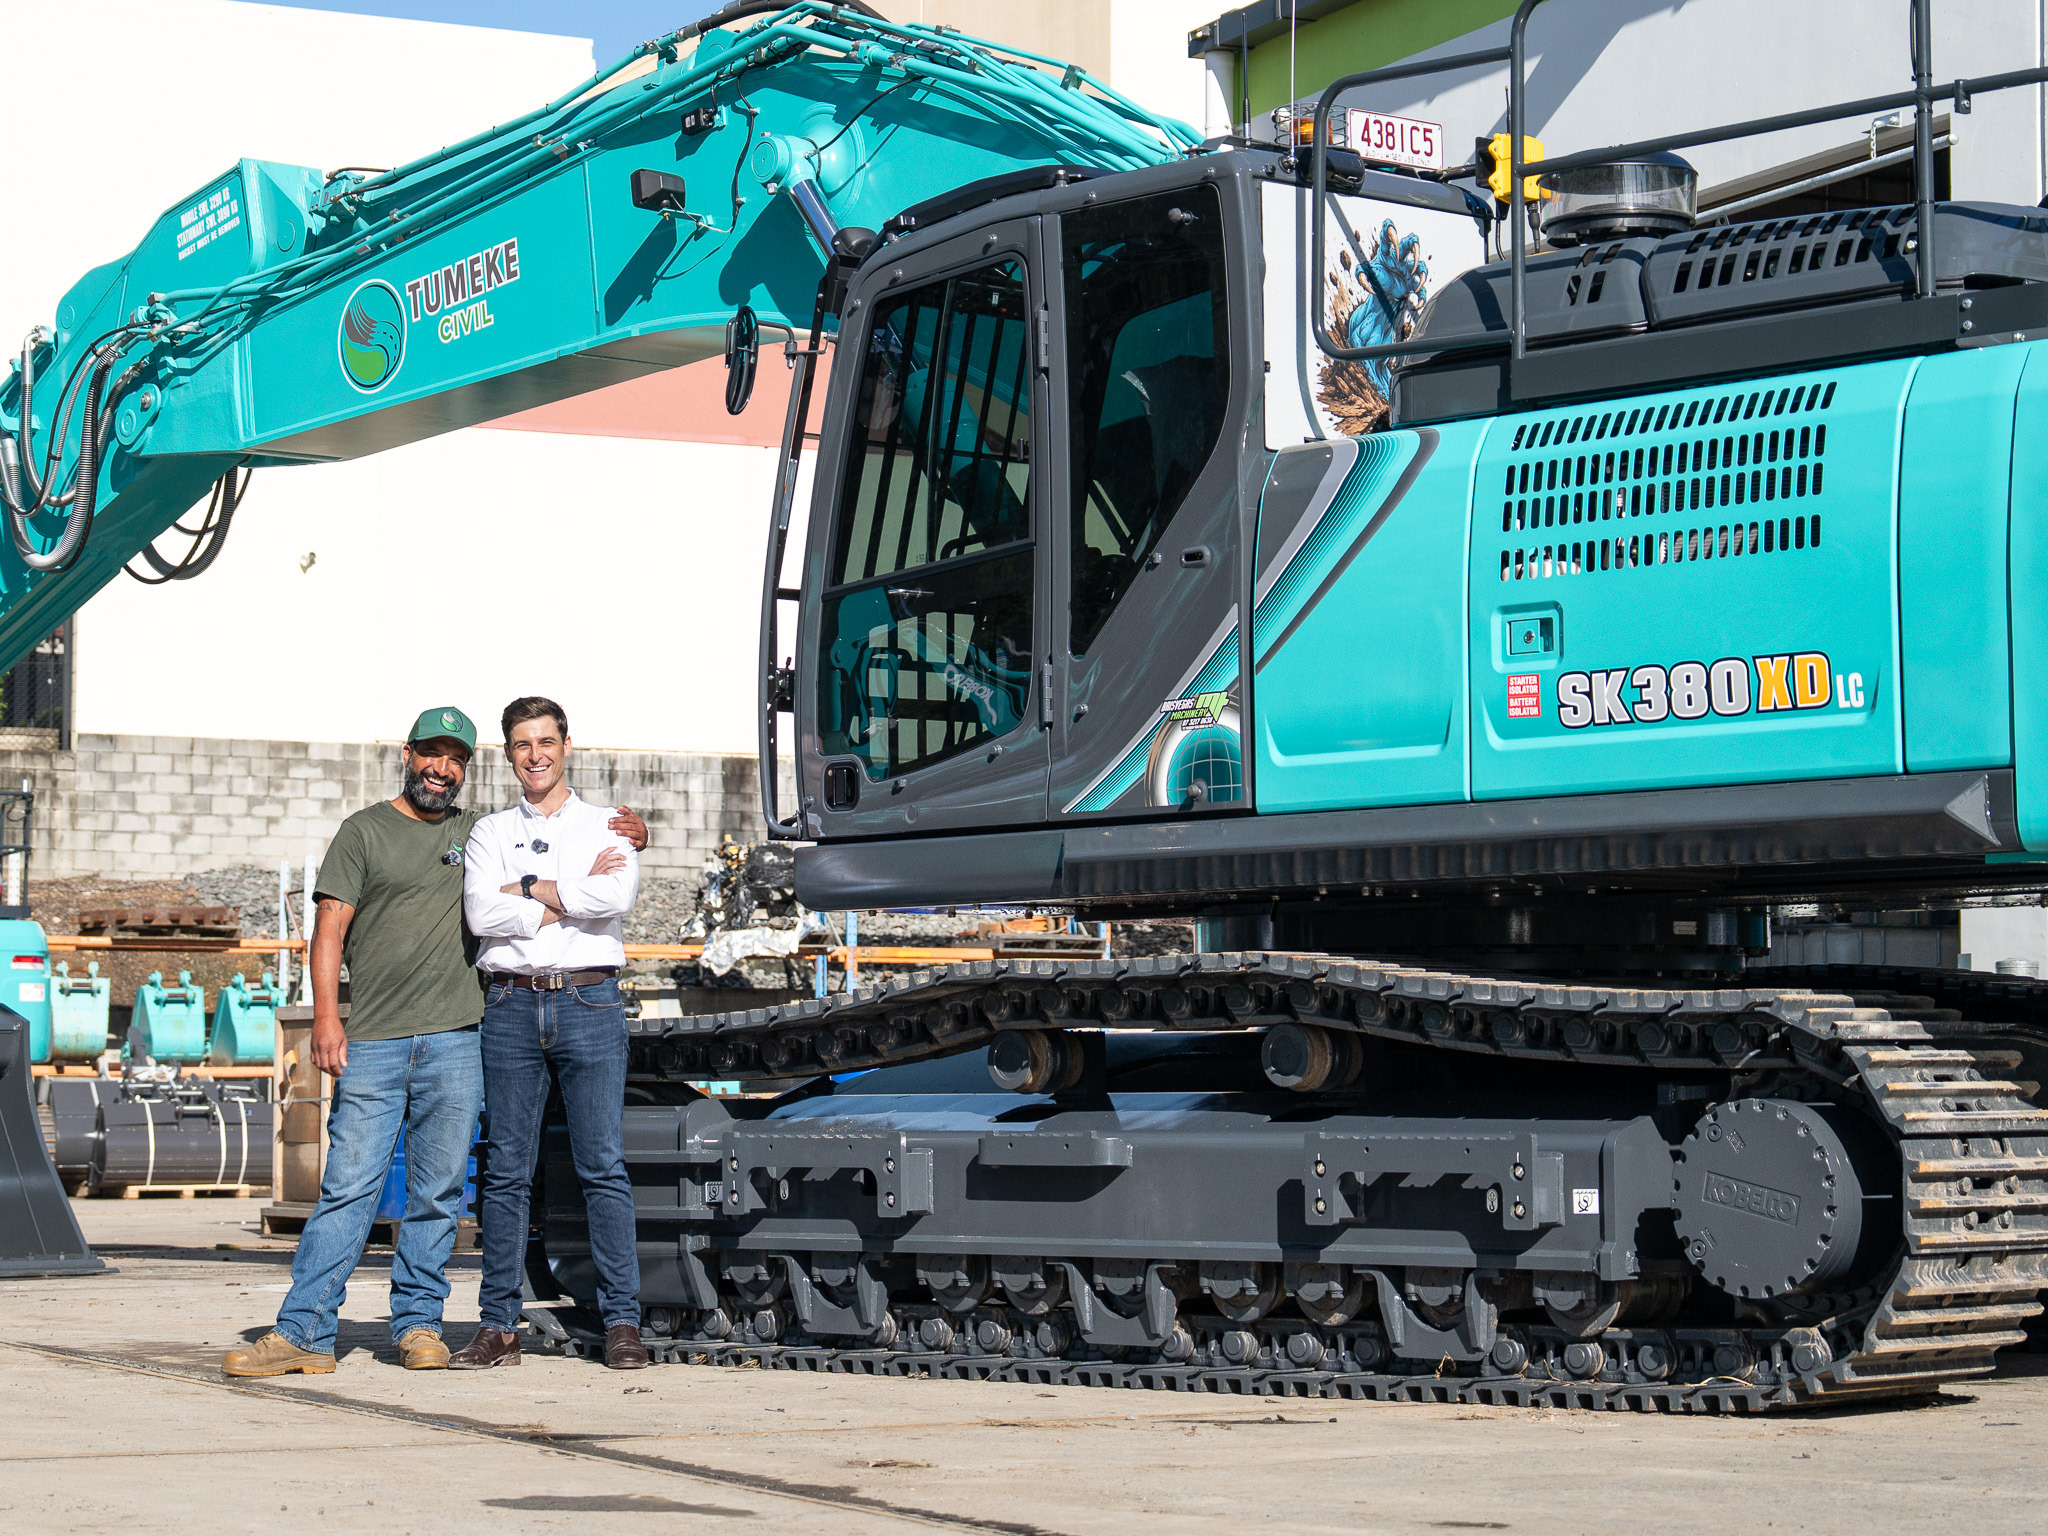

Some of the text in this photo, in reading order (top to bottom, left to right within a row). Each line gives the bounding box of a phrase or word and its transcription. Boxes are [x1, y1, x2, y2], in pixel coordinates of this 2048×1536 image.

[198, 200, 210, 218] SWL
[222, 186, 230, 202] KG
[177, 219, 205, 249] STATIONARY
[205, 213, 217, 230] SWL
[230, 199, 238, 215] KG
[178, 216, 240, 261] BUCKET MUST BE REMOVED
[405, 237, 520, 323] TUMEKE
[438, 299, 494, 344] CIVIL
[1509, 676, 1538, 685] STARTER
[1509, 685, 1539, 694] ISOLATOR
[1836, 672, 1865, 708] LC
[1170, 707, 1209, 720] MACHINERY
[1509, 697, 1537, 706] BATTERY
[1509, 706, 1539, 716] ISOLATOR
[1704, 1174, 1797, 1221] KOBELCO
